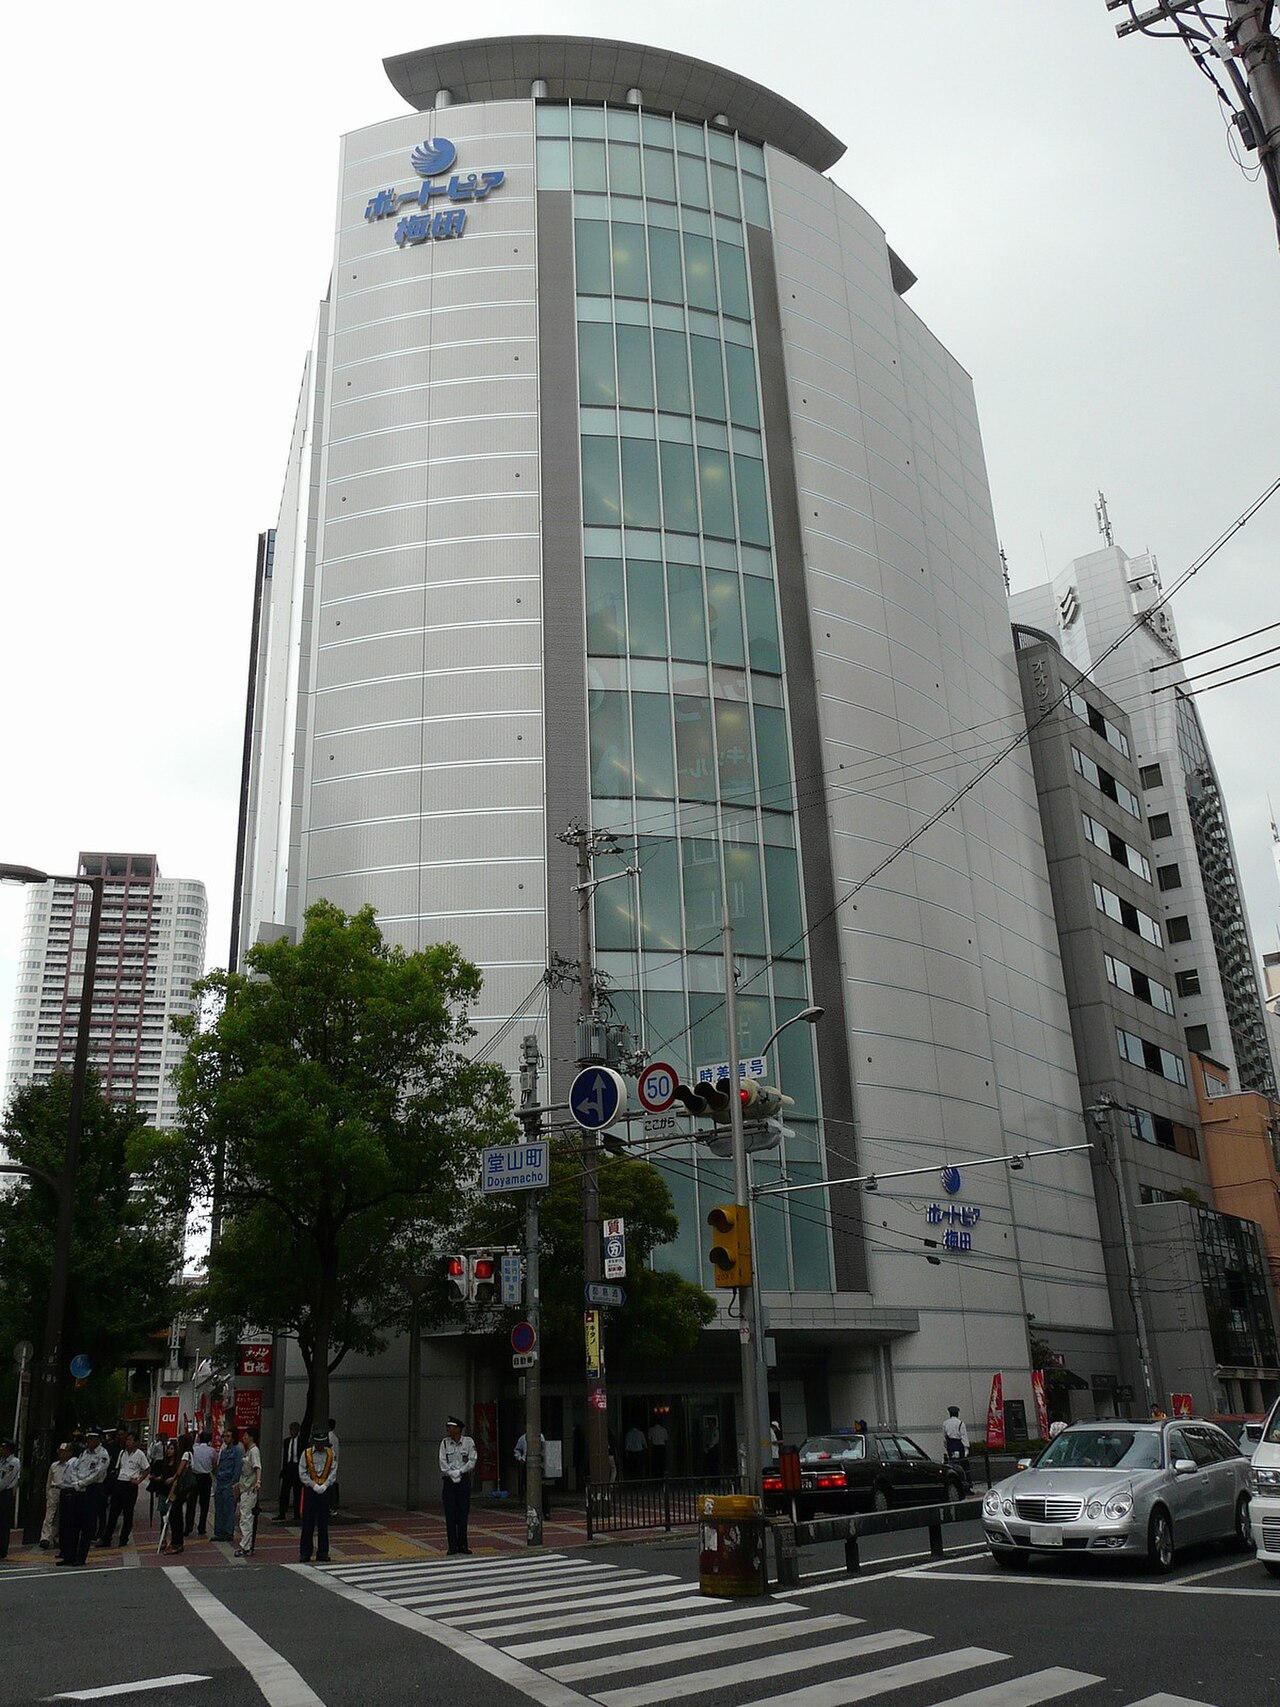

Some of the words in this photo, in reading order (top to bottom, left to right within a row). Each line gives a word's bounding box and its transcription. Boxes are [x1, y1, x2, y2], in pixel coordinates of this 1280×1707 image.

[364, 171, 506, 221] ボートピア
[394, 208, 468, 246] 梅田
[646, 1076, 671, 1100] 50
[644, 1117, 675, 1131] ここから
[487, 1148, 543, 1173] 堂山町
[487, 1171, 543, 1188] Doyamacho
[942, 1229, 972, 1250] 梅田
[161, 1413, 176, 1423] au
